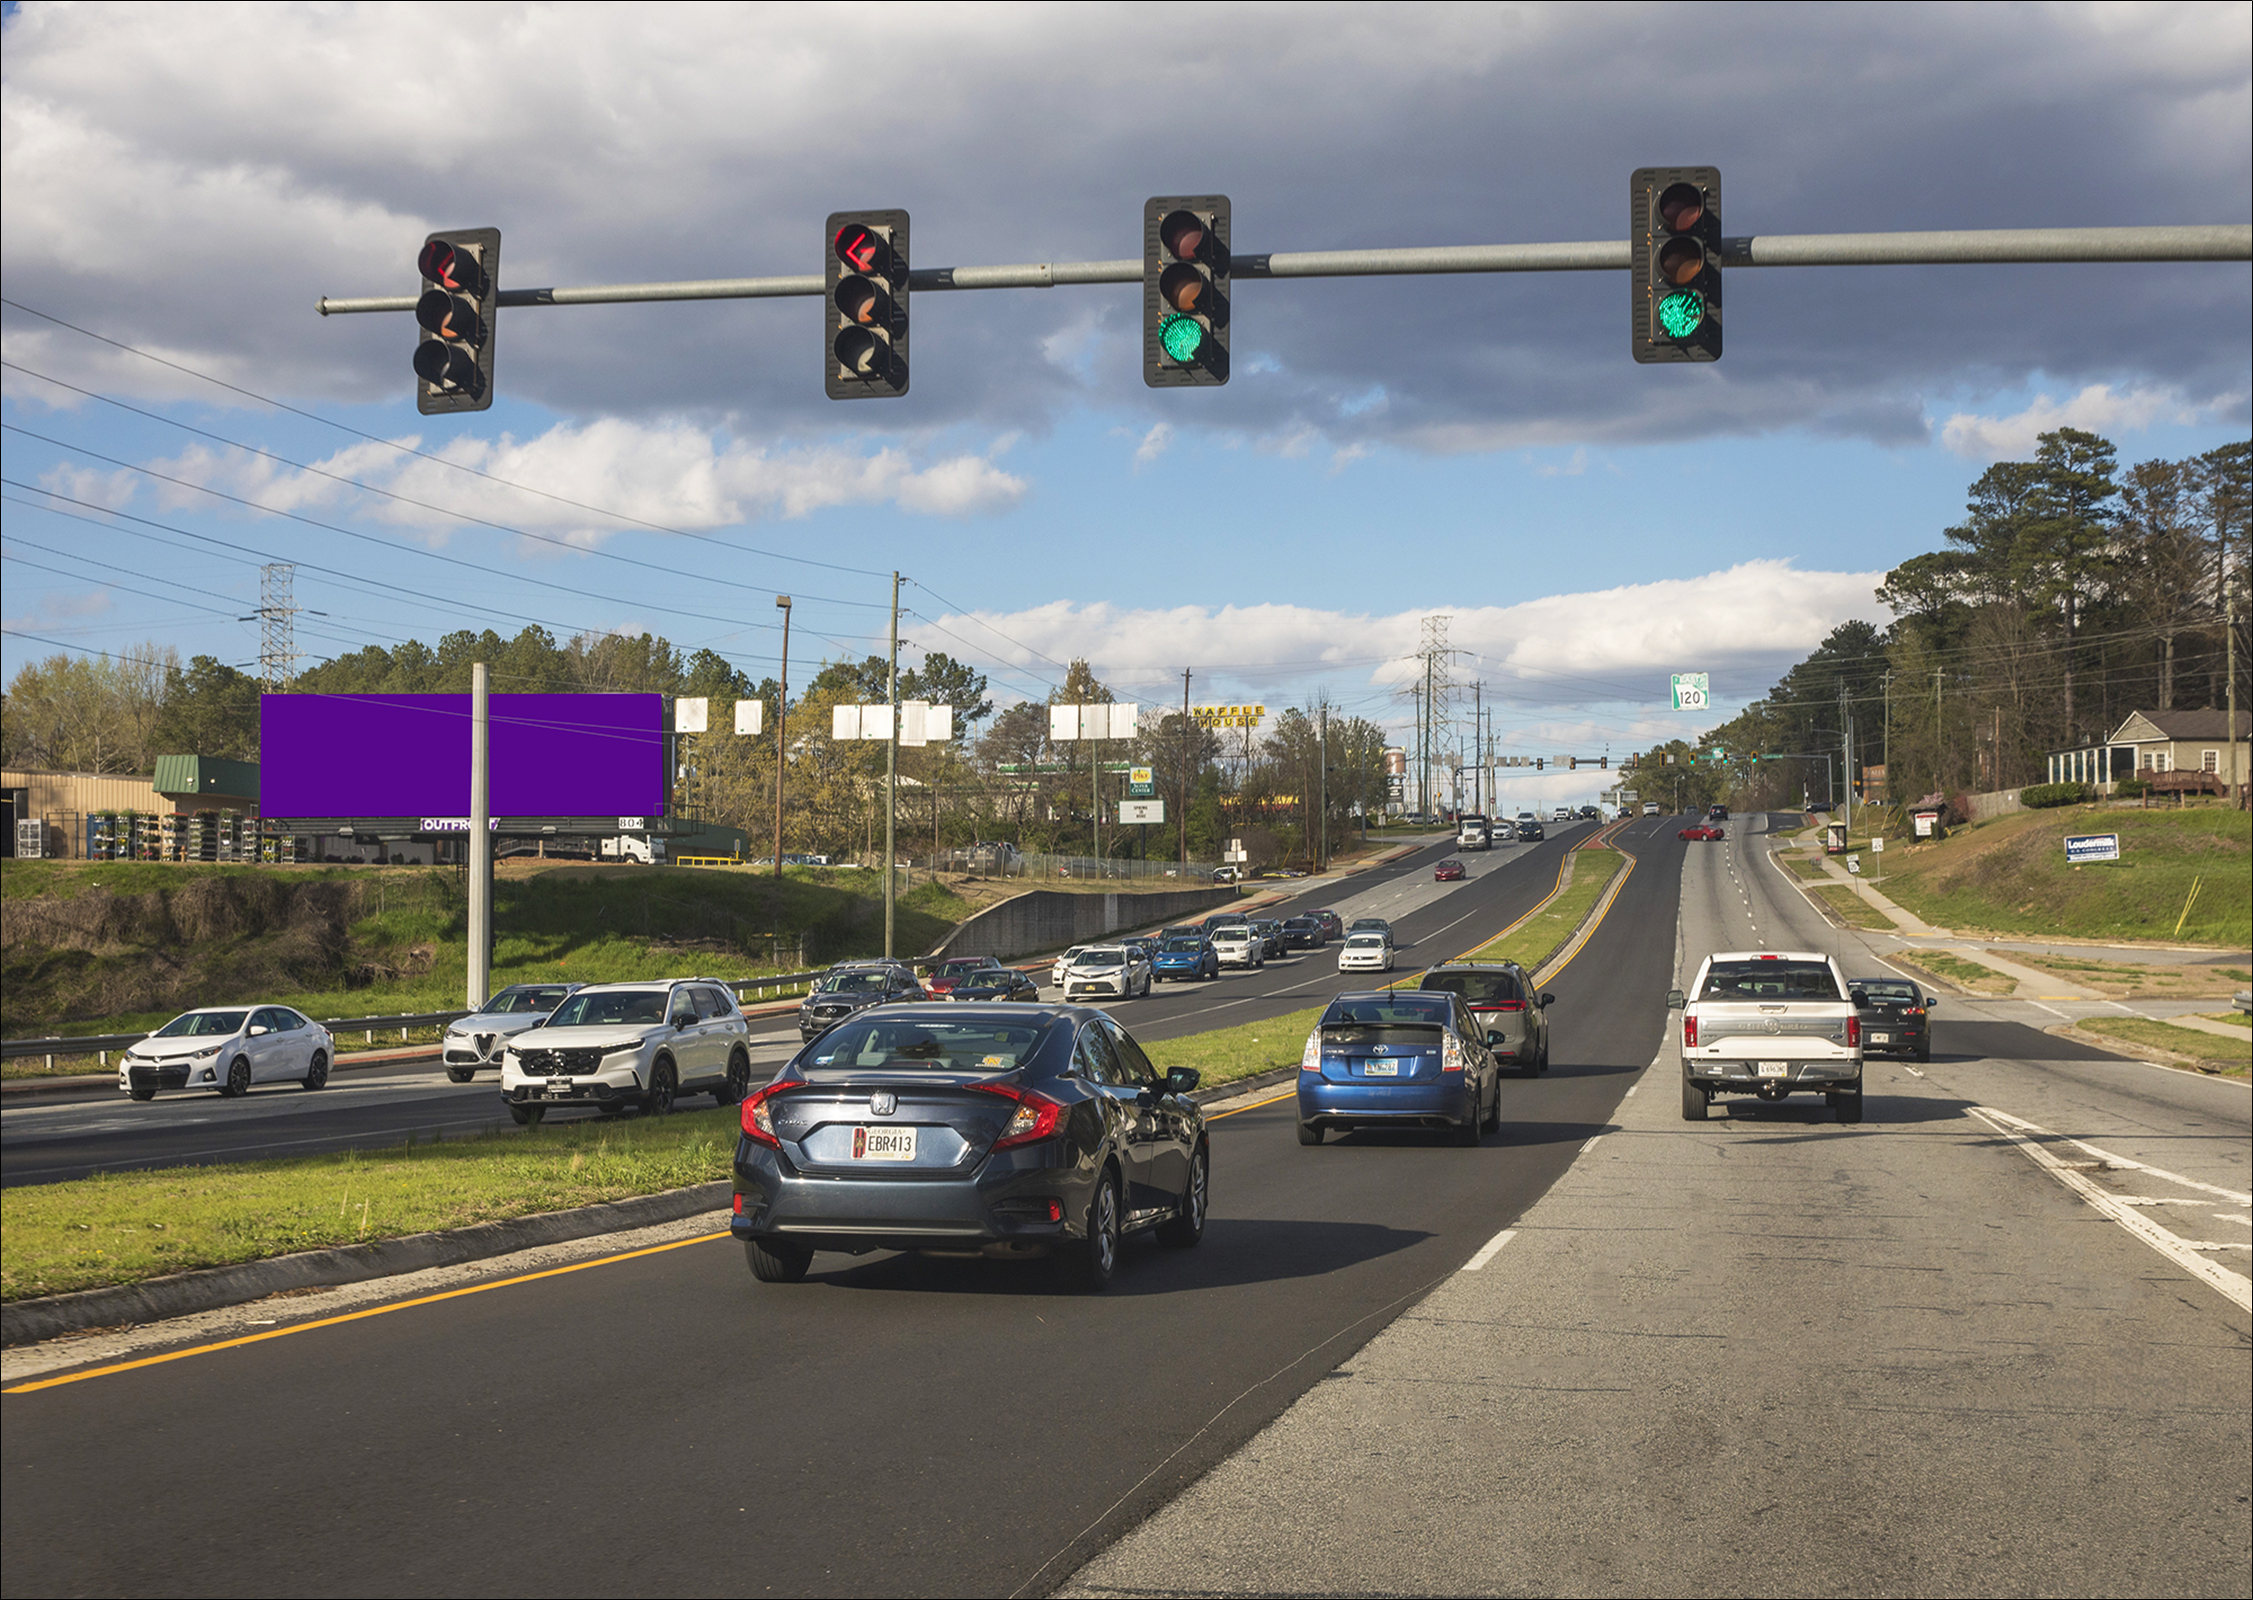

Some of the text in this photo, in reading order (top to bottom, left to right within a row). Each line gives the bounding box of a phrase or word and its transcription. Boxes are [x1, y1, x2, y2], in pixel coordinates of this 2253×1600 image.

[1680, 691, 1701, 704] 120
[1193, 706, 1263, 716] WAFFLE
[1200, 718, 1258, 728] HOUSE
[2067, 837, 2115, 849] Loudermilk
[868, 1136, 912, 1152] EBR413
